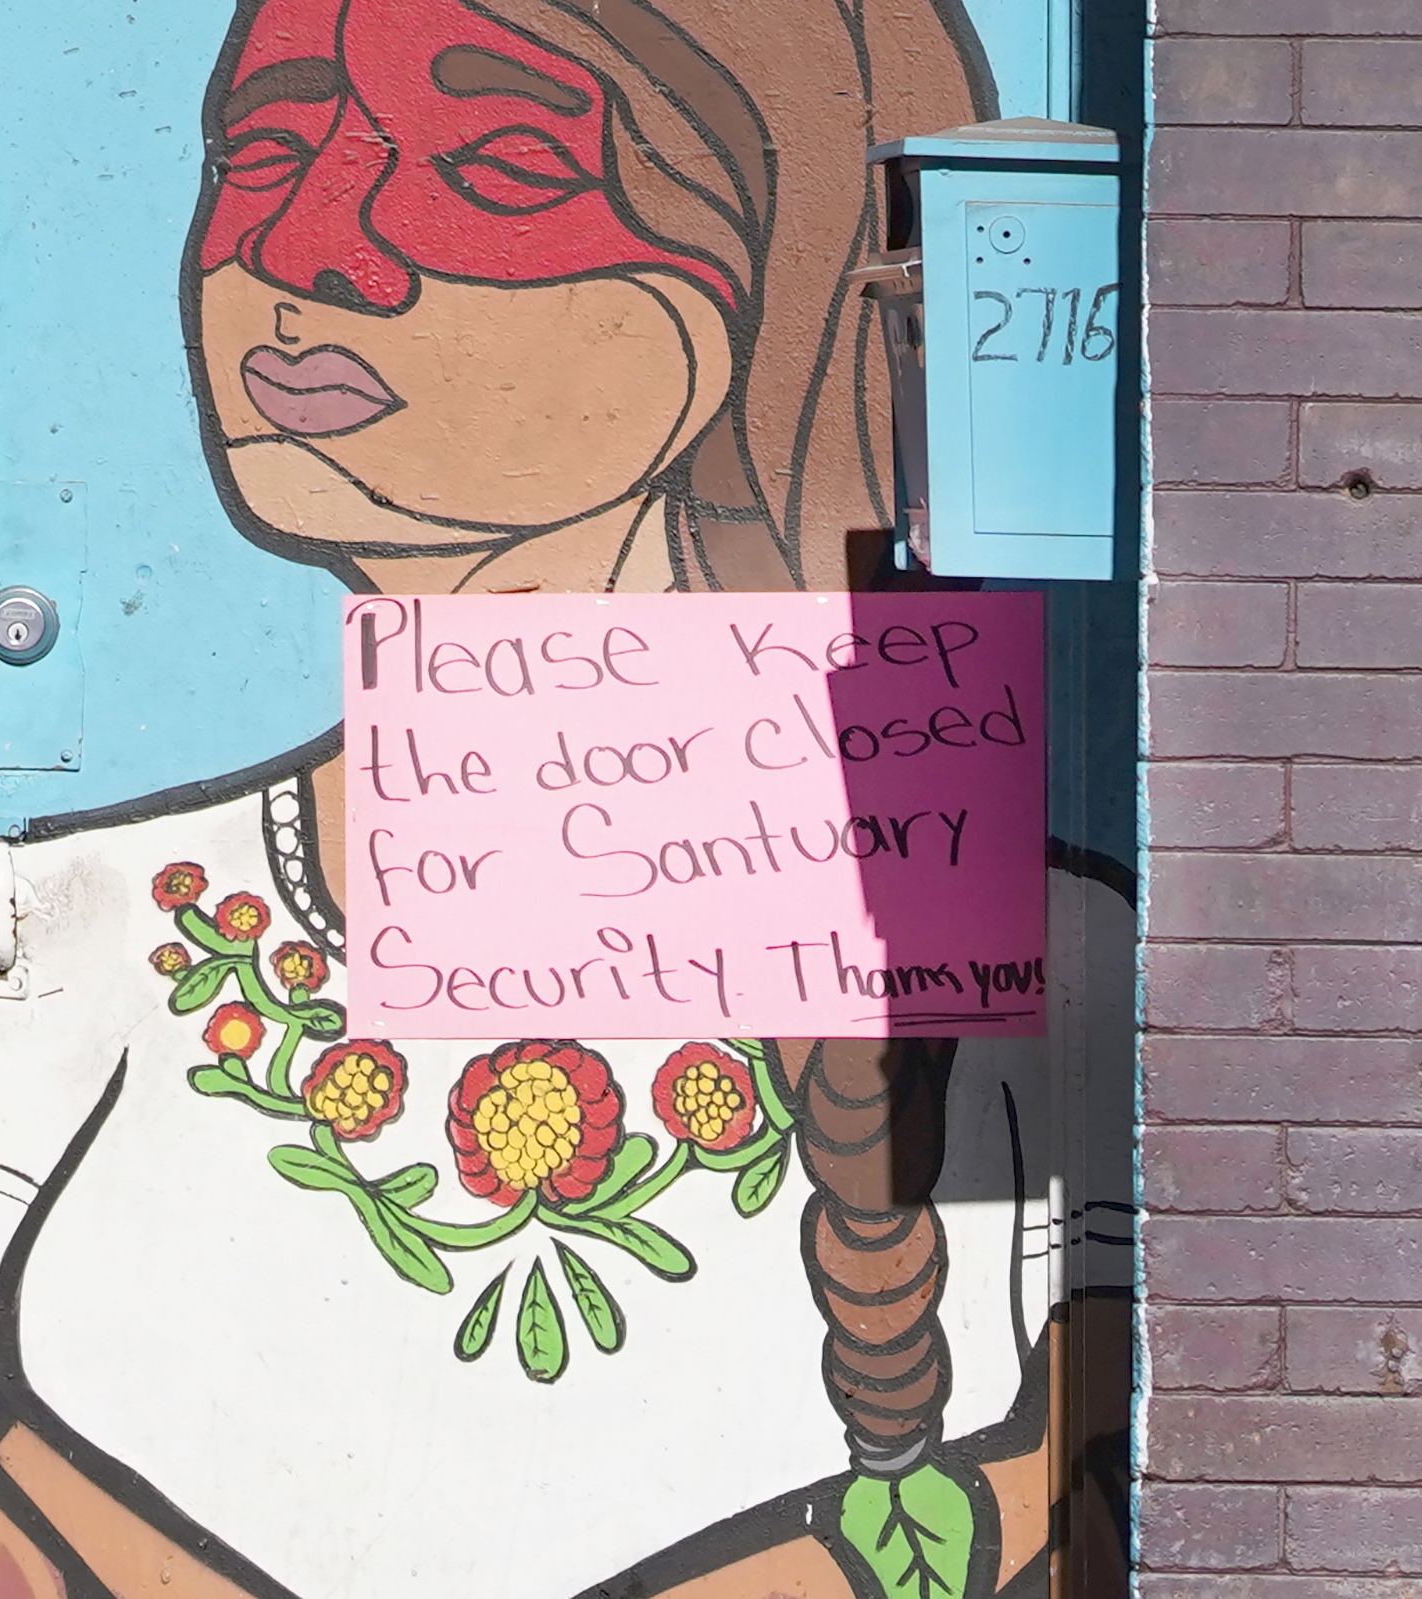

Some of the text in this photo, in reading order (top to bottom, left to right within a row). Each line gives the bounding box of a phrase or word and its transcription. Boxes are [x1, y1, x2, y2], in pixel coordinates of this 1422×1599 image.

[972, 282, 1124, 365] 2716
[345, 597, 659, 696] Please
[359, 724, 497, 803] the
[536, 727, 715, 794] door
[561, 801, 970, 899] Santuary
